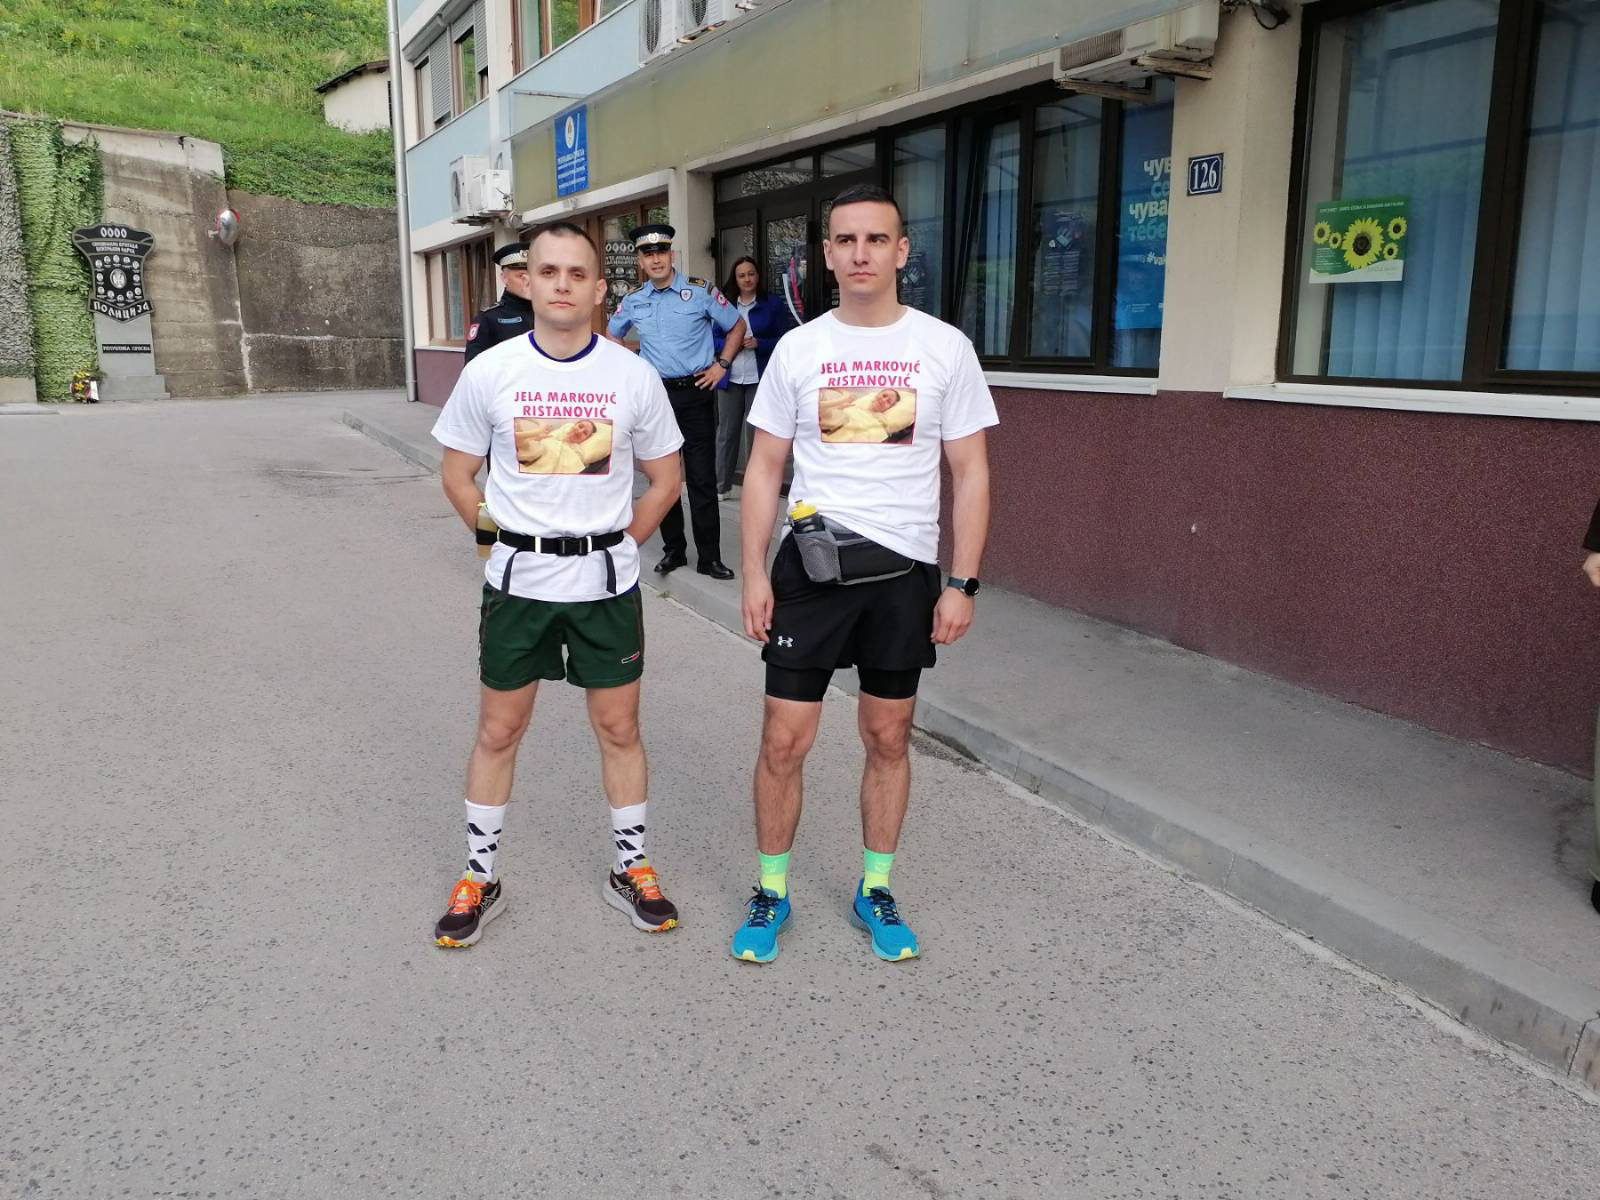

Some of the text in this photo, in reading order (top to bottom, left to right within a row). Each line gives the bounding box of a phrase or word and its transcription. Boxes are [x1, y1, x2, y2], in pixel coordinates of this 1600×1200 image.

[1193, 161, 1218, 189] 126
[820, 360, 920, 375] JELA MARKOVIĆ
[828, 373, 911, 387] RISTANOVIĆ
[514, 391, 617, 405] JELA MARKOVIĆ
[522, 404, 607, 418] RISTANOVIĆ
